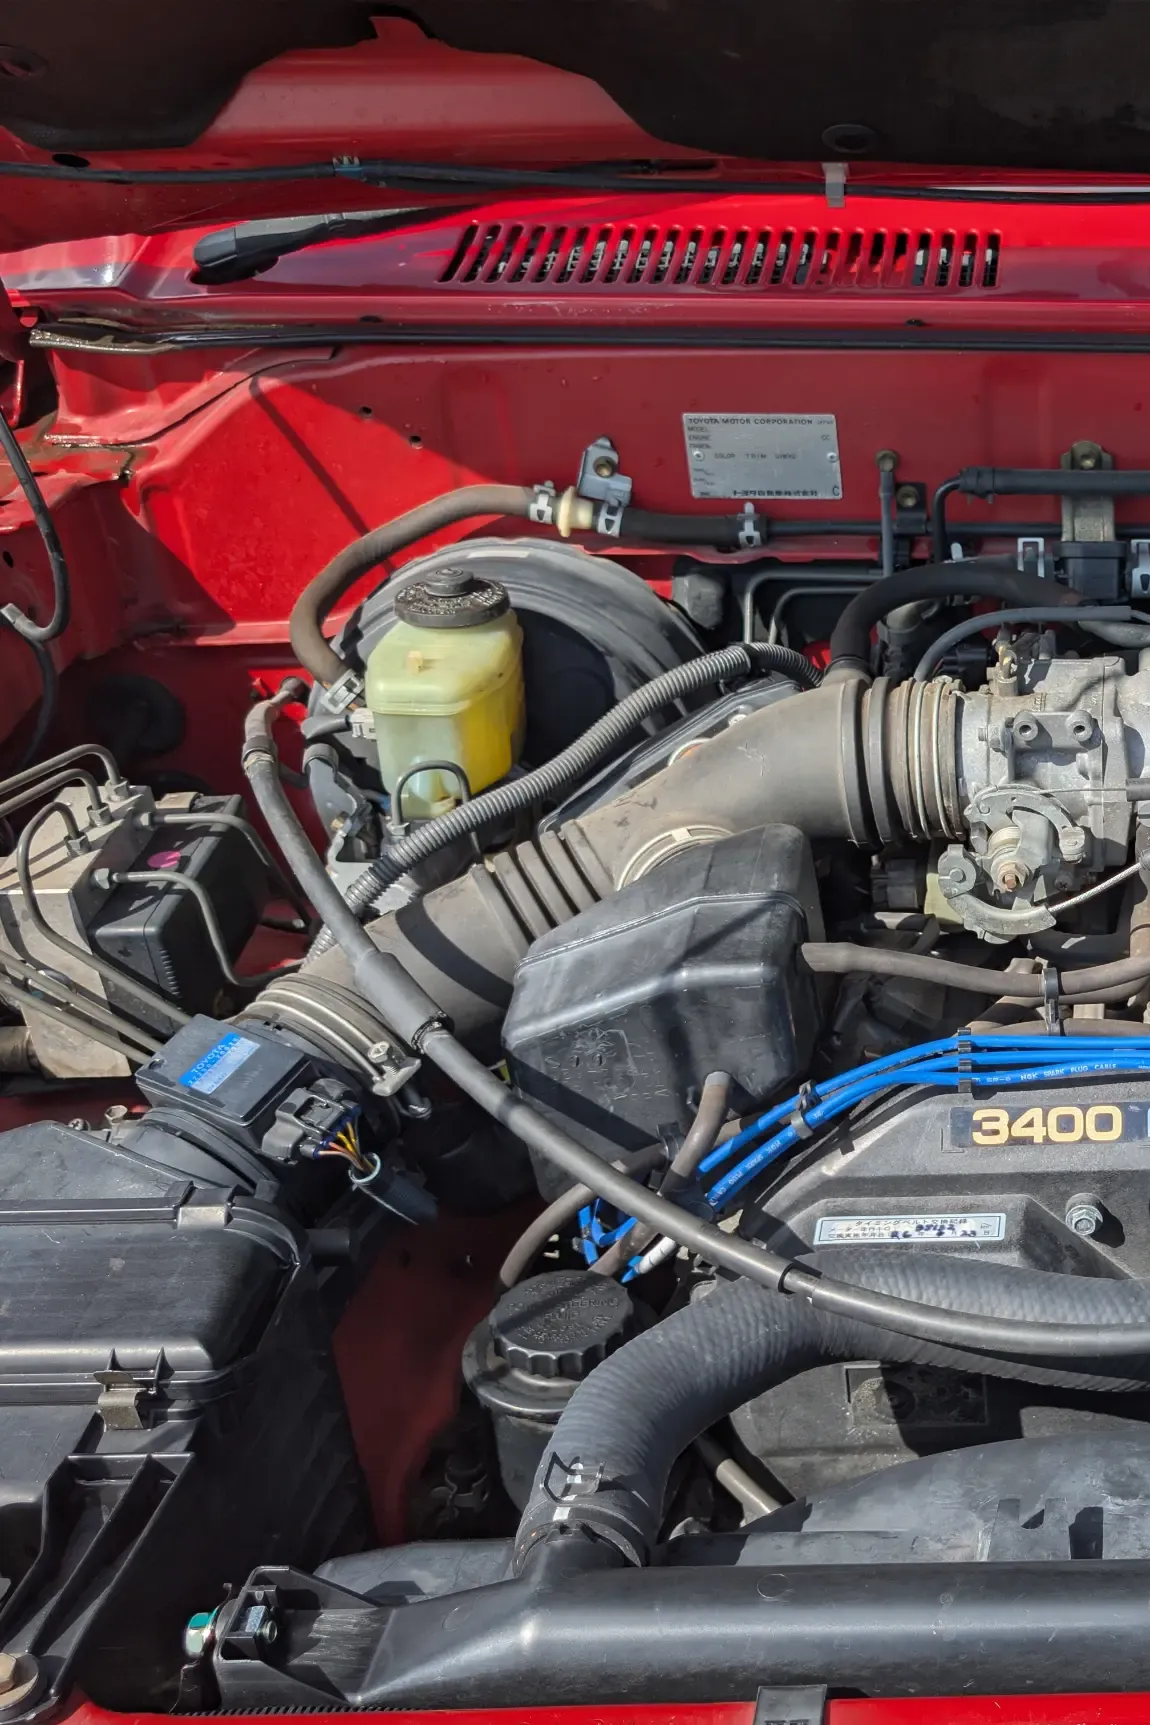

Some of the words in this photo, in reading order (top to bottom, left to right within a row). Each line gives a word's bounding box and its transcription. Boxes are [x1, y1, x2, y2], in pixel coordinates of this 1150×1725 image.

[688, 417, 720, 426] TOYOTA
[723, 418, 751, 426] MOTOR
[754, 418, 813, 426] CORPORATION
[191, 1044, 226, 1073] TOYOTA
[1020, 1072, 1038, 1080] NGK
[1043, 1068, 1065, 1078] SPARK
[1070, 1066, 1088, 1074] PLUG
[971, 1105, 1124, 1145] 3400
